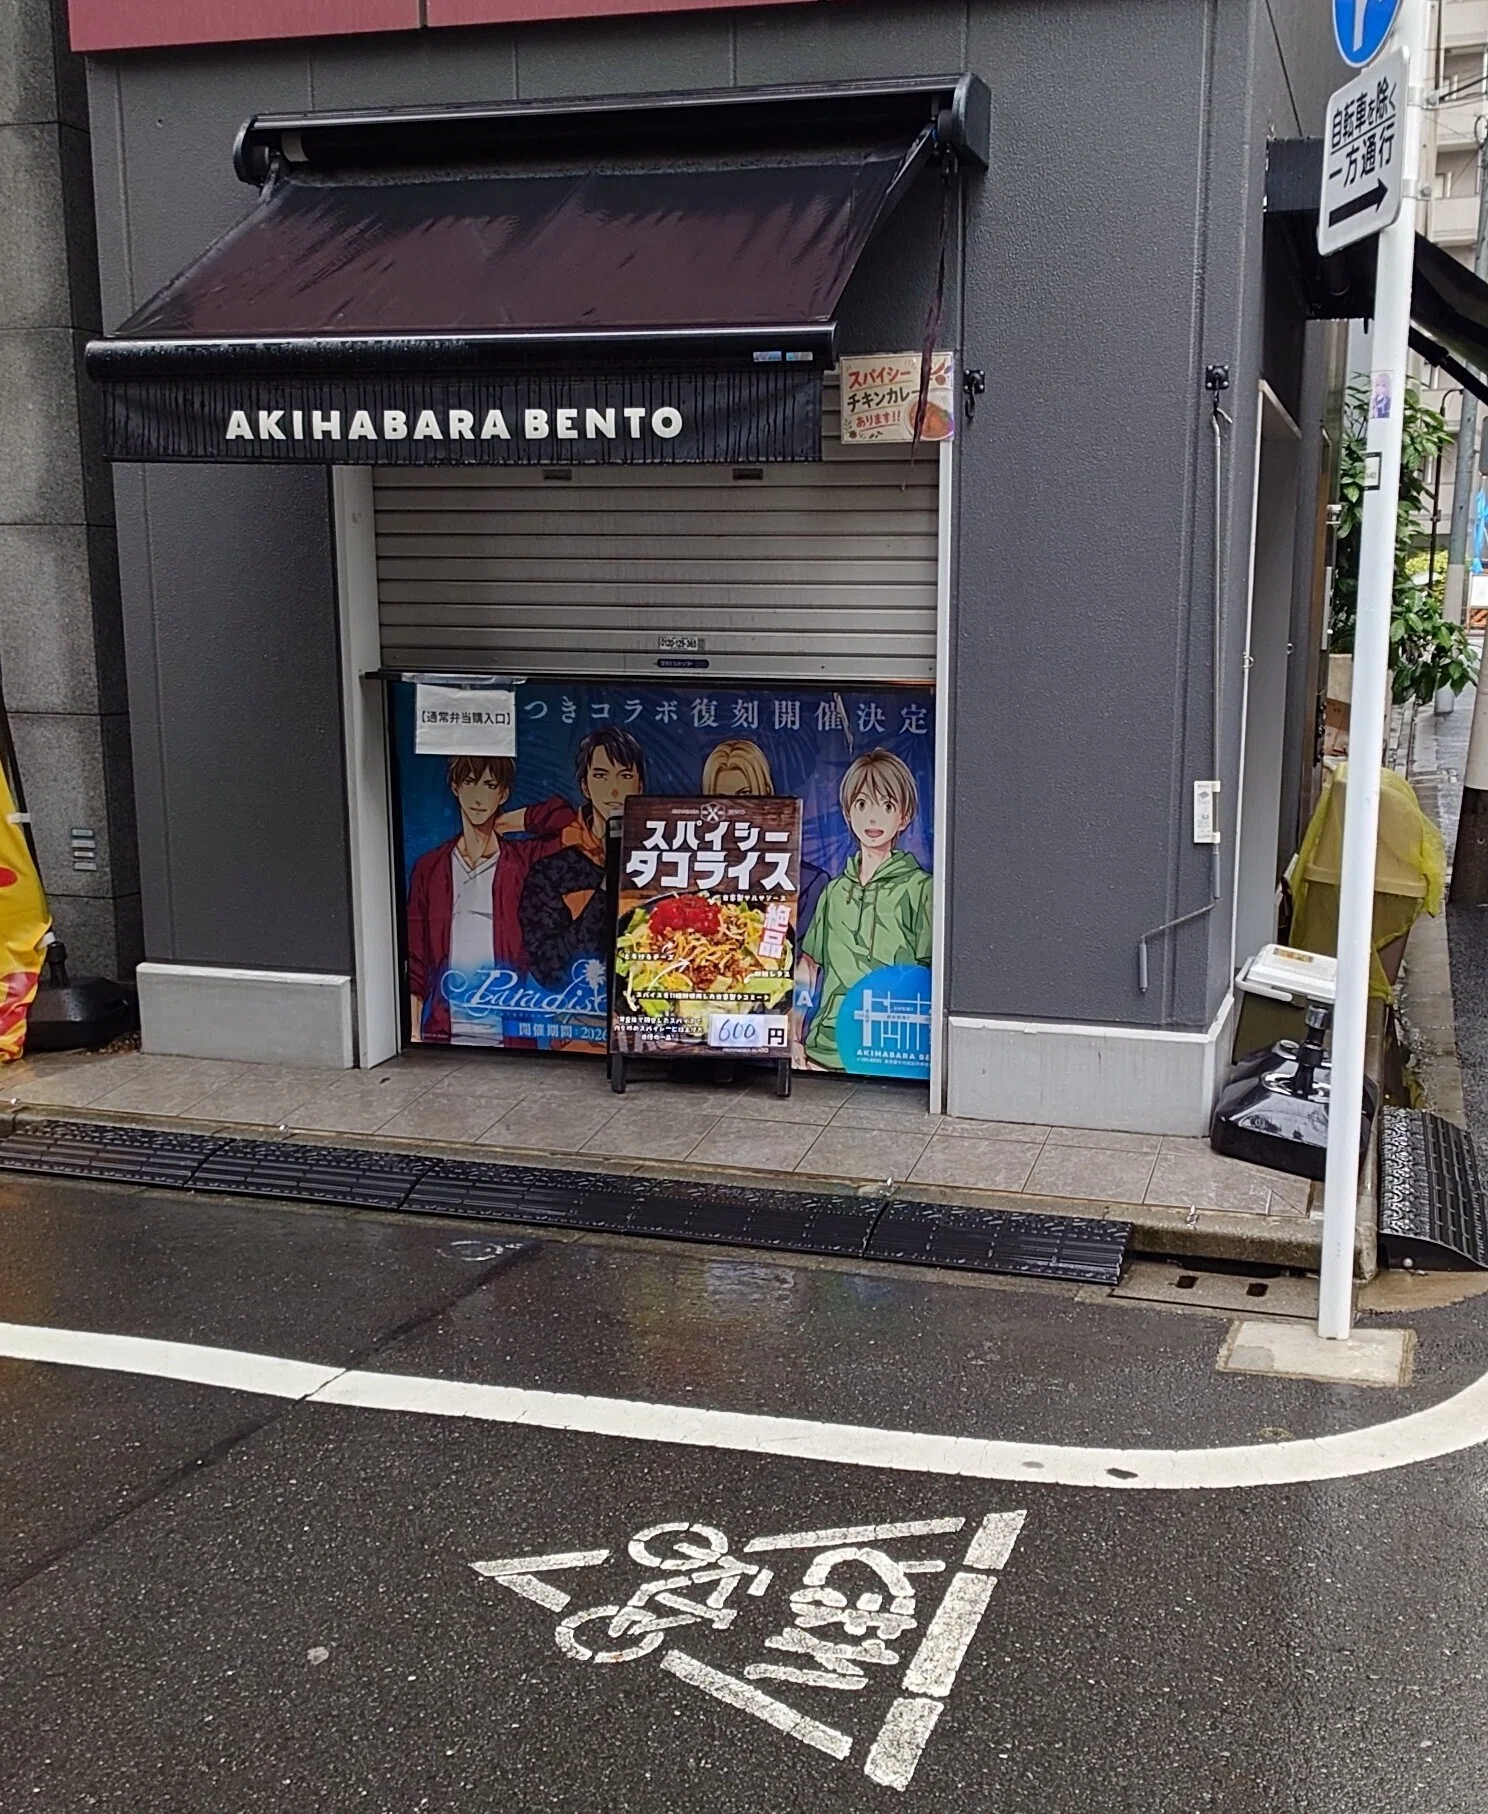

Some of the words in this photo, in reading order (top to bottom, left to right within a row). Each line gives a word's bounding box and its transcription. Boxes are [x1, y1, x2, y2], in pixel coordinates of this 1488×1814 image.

[1331, 75, 1397, 149] 自転車を除く
[1329, 122, 1396, 188] 一方通行
[848, 366, 912, 389] スパイシー
[846, 386, 921, 412] チキンカレー
[225, 408, 512, 441] AKIHABARA
[524, 406, 685, 440] BENTO
[421, 710, 511, 725] 【通常弁当購入口】
[642, 820, 791, 851] スパイシー
[625, 850, 797, 891] タコライス
[718, 1019, 757, 1042] 600
[768, 1027, 785, 1045] 円
[856, 1048, 915, 1060] AKIHABARA
